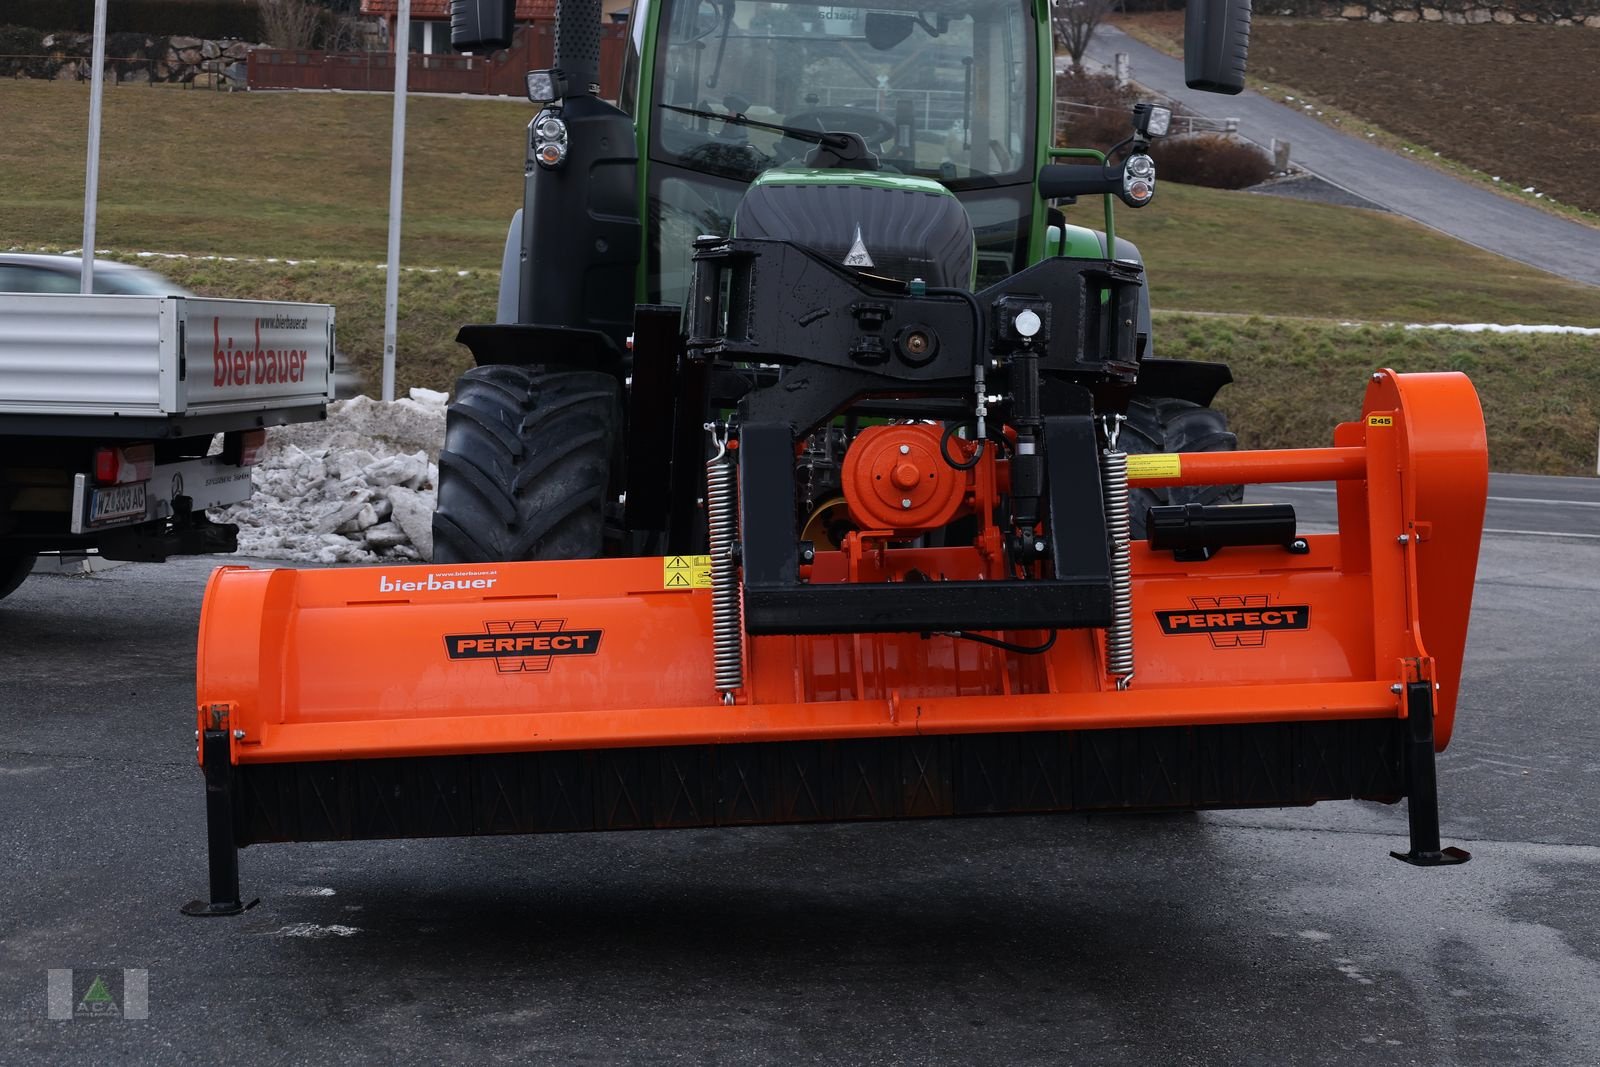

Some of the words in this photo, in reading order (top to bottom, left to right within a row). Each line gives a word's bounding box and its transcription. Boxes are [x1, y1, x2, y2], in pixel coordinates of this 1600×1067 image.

[260, 314, 307, 329] www.bierbauer.at
[213, 316, 307, 387] bierbauer
[380, 574, 496, 592] bierbauer
[1169, 611, 1298, 628] PERFECT
[457, 636, 589, 653] PERFECT
